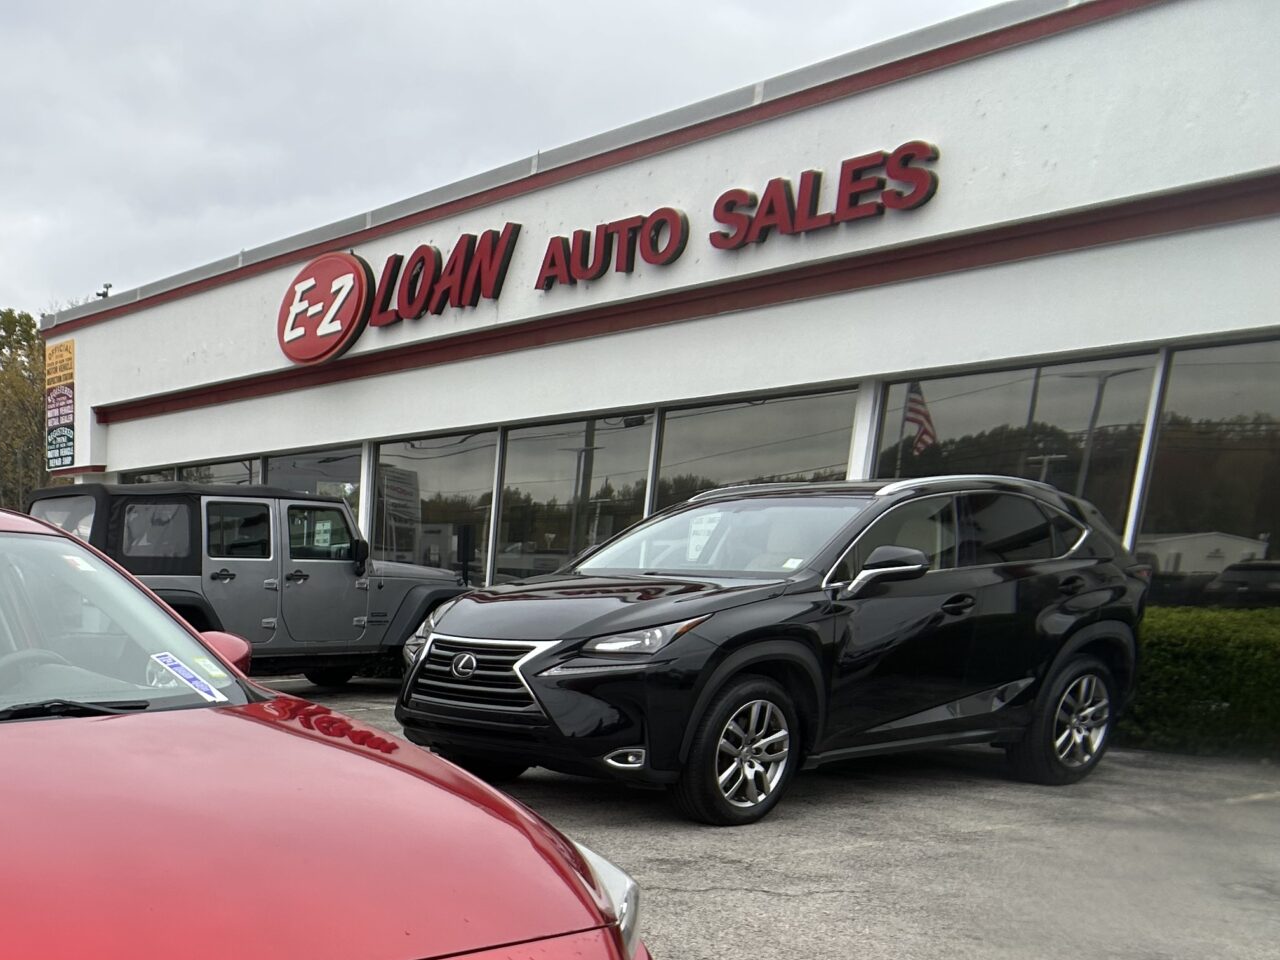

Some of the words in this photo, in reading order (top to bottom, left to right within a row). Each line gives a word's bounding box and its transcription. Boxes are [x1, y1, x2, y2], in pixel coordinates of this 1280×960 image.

[284, 266, 354, 343] E-Z
[369, 222, 522, 327] LOAN
[535, 207, 689, 290] AUTO
[709, 140, 939, 250] SALES
[48, 343, 72, 361] OFFICIAL
